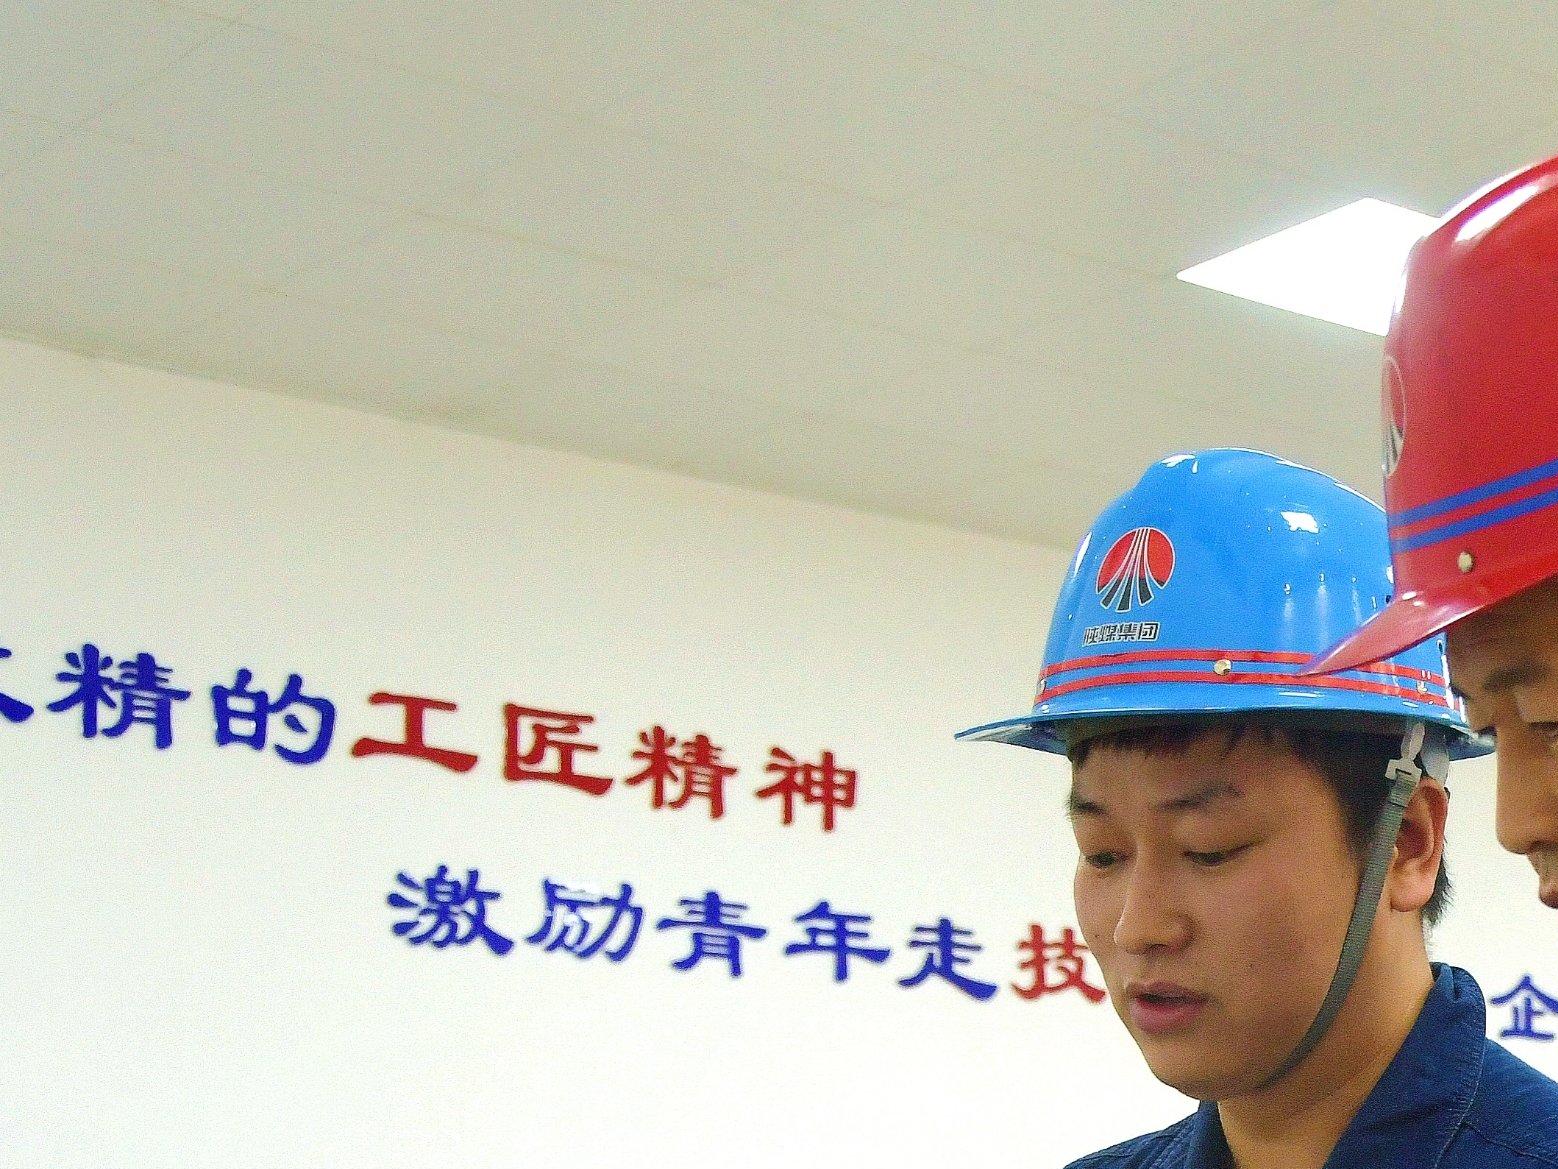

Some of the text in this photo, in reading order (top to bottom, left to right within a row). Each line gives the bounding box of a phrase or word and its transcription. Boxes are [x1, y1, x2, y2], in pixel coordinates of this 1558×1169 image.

[386, 864, 1107, 1004] 激励青年走技
